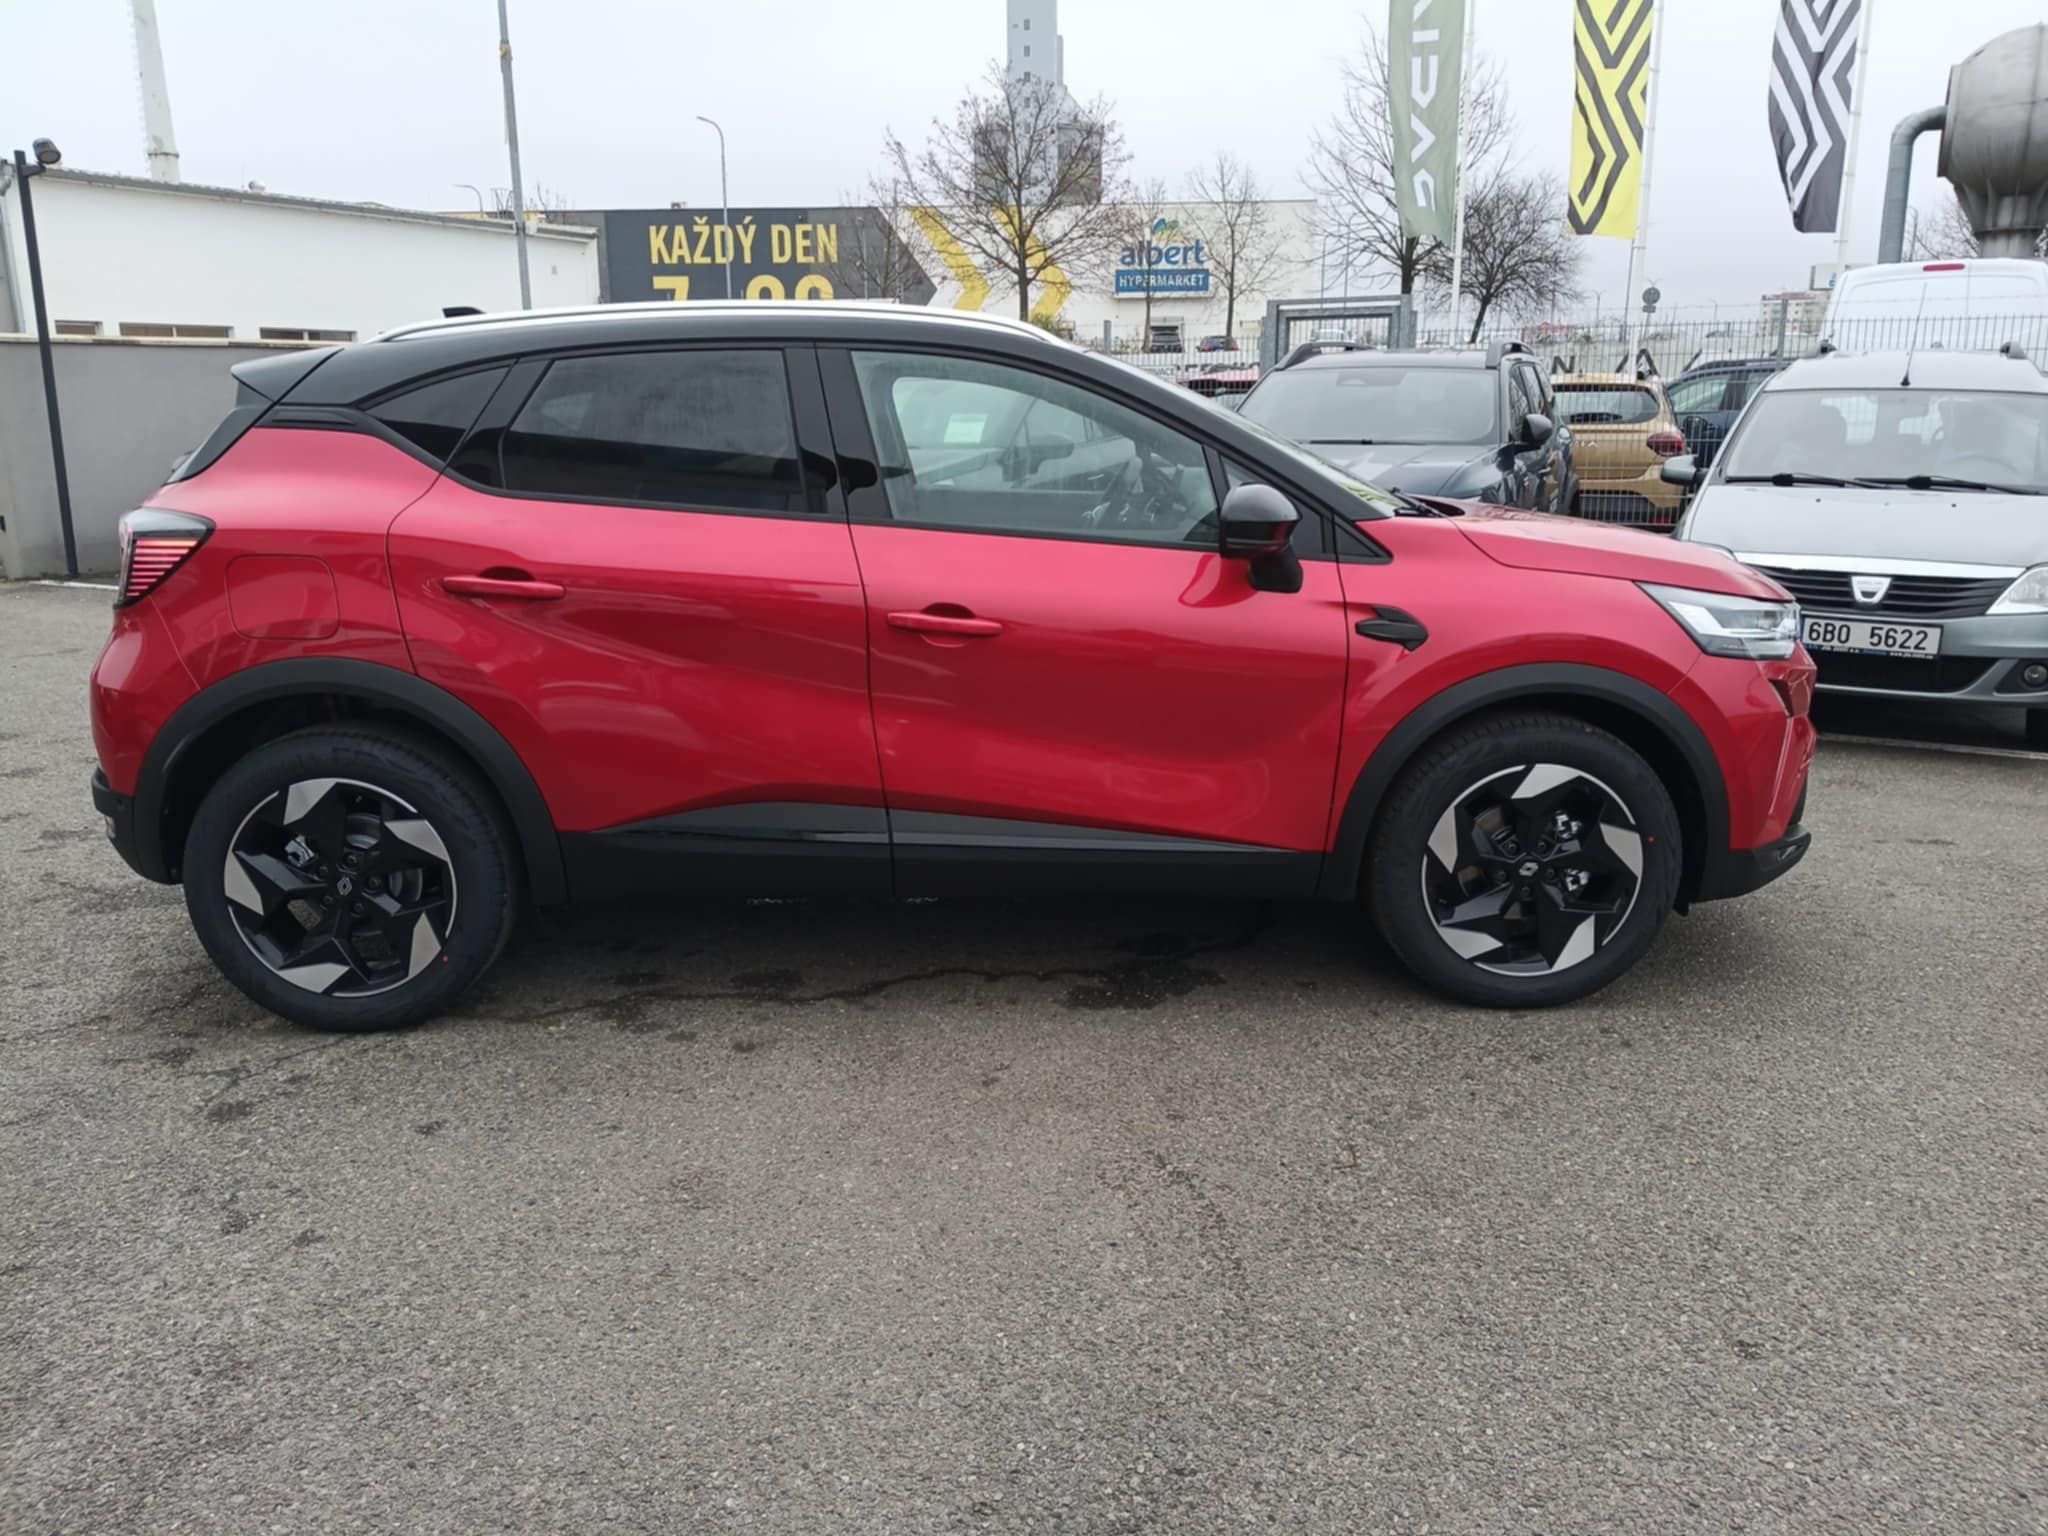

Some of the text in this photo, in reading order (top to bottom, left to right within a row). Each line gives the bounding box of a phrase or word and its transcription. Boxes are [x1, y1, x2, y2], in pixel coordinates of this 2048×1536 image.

[649, 216, 838, 265] KAŽDÝ DEN
[1120, 239, 1206, 267] albert
[1869, 626, 1928, 651] 5622
